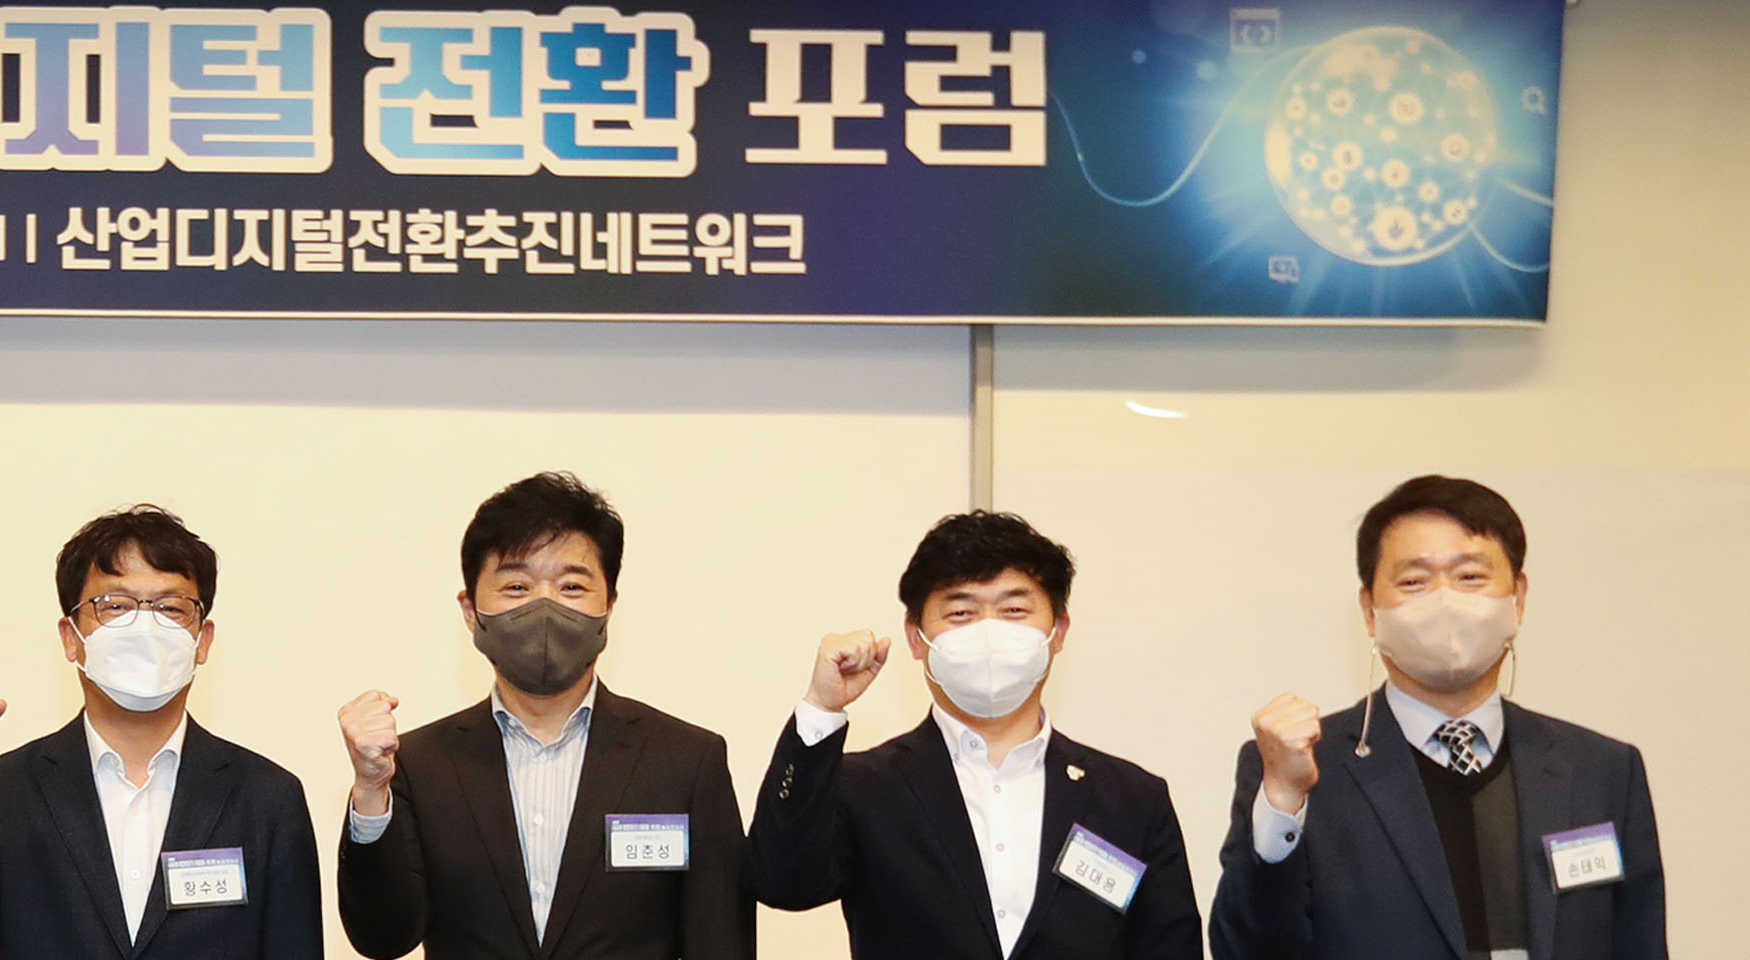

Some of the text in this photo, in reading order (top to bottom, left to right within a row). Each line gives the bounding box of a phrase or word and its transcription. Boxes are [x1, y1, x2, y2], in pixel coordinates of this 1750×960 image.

[363, 6, 710, 177] 전환
[745, 29, 1047, 166] 포럼
[56, 207, 806, 275] 산업디지털전환추진네트워크
[625, 843, 670, 861] 임춘성
[183, 878, 228, 897] 황수성
